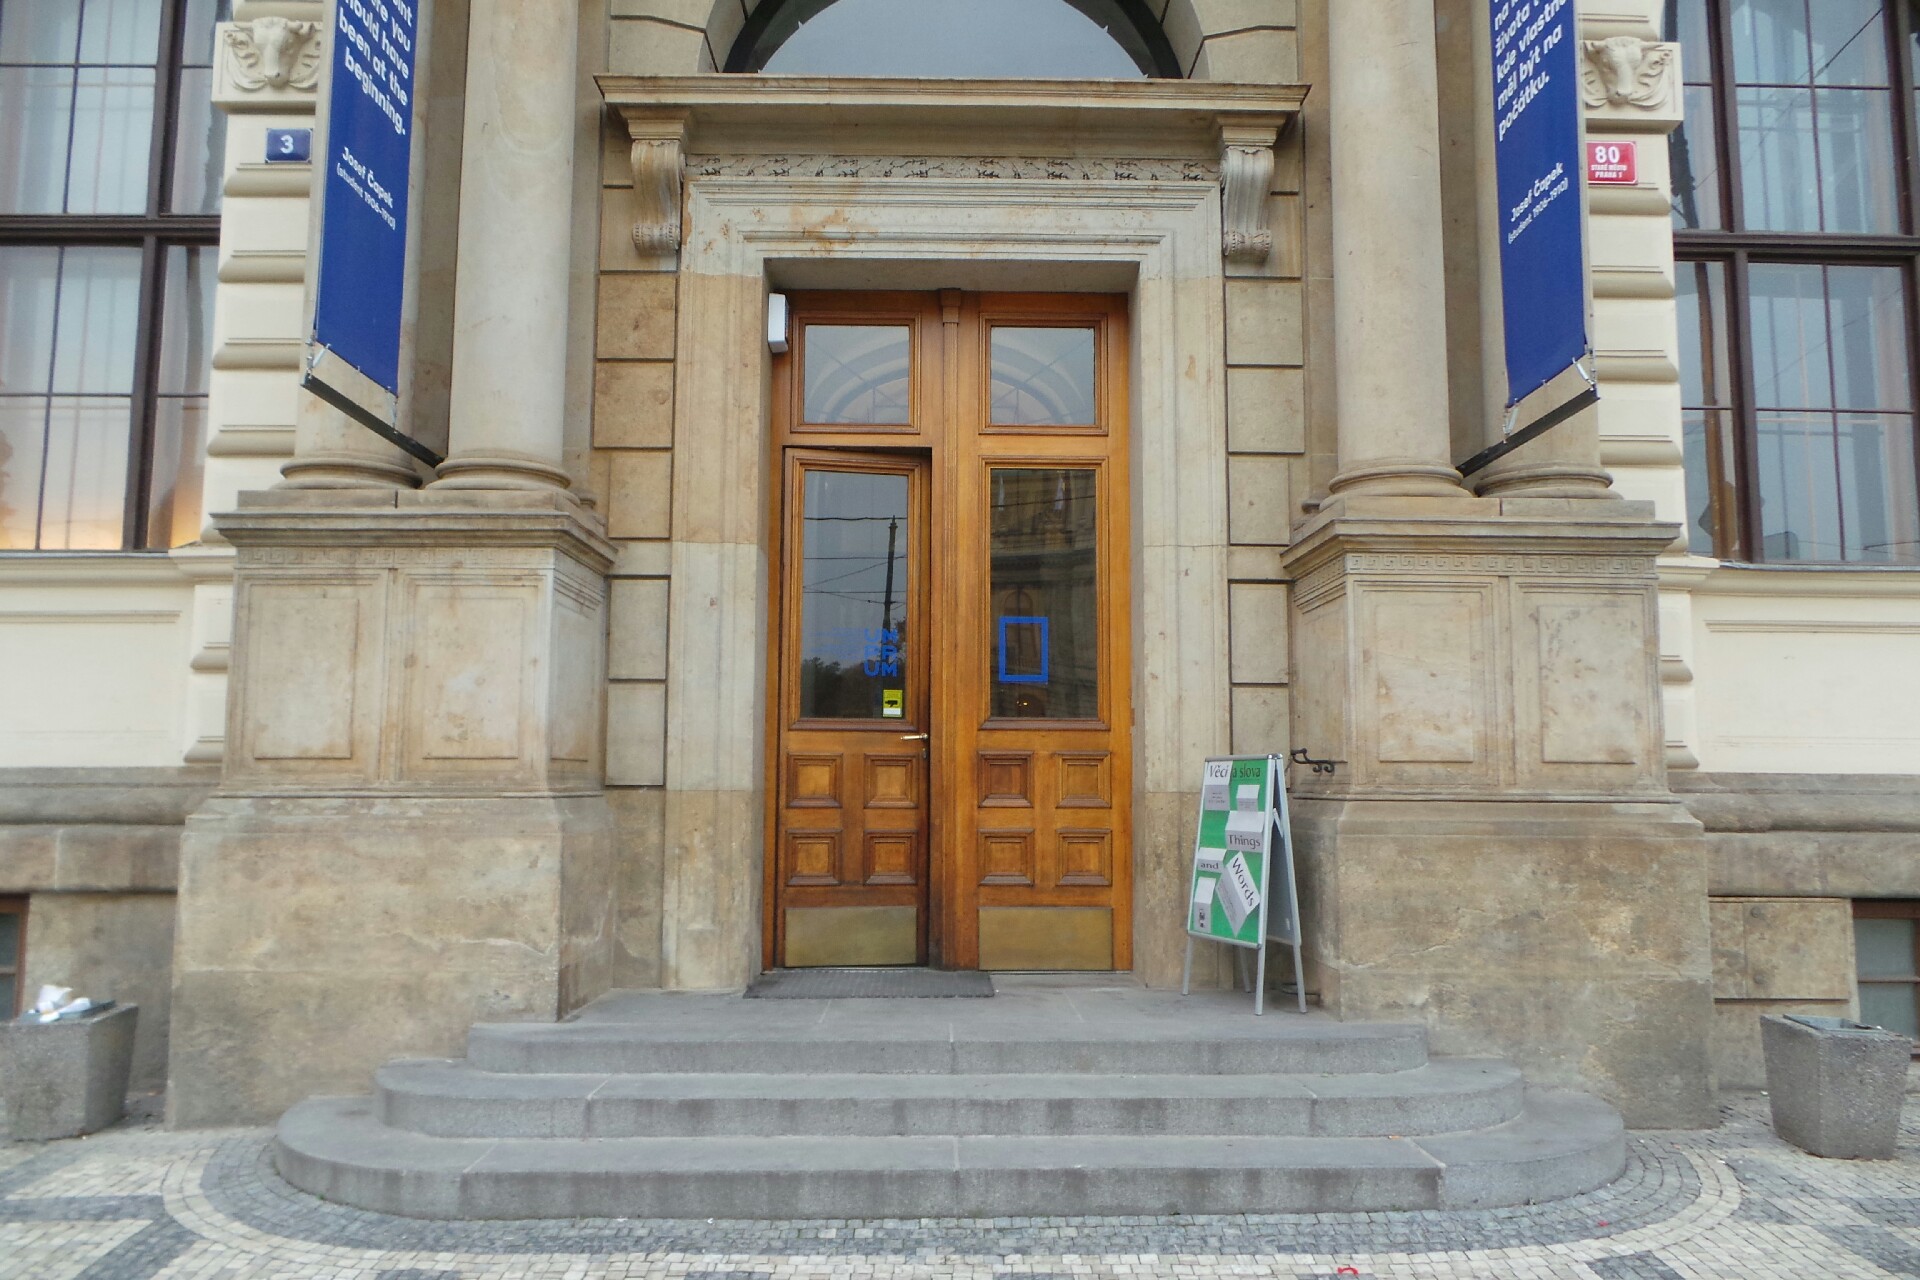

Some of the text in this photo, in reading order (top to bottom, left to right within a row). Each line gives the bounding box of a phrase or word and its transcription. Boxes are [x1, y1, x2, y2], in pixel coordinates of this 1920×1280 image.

[392, 17, 411, 52] you
[1494, 2, 1509, 31] na
[1495, 3, 1531, 57] života
[340, 7, 408, 106] been at the
[381, 30, 409, 79] have
[1496, 49, 1517, 84] kde
[1497, 24, 1562, 110] měl být na
[345, 46, 406, 136] beginning.
[1499, 71, 1550, 142] počátku.
[280, 134, 294, 154] 3
[1594, 146, 1620, 163] 80
[342, 146, 394, 209] Josef Čapek
[1511, 162, 1564, 222] Josef Čapek
[863, 660, 898, 678] UM
[1209, 763, 1261, 778] Věci a slova
[1228, 834, 1261, 850] Things
[1200, 862, 1219, 870] and
[1232, 857, 1255, 907] Words
